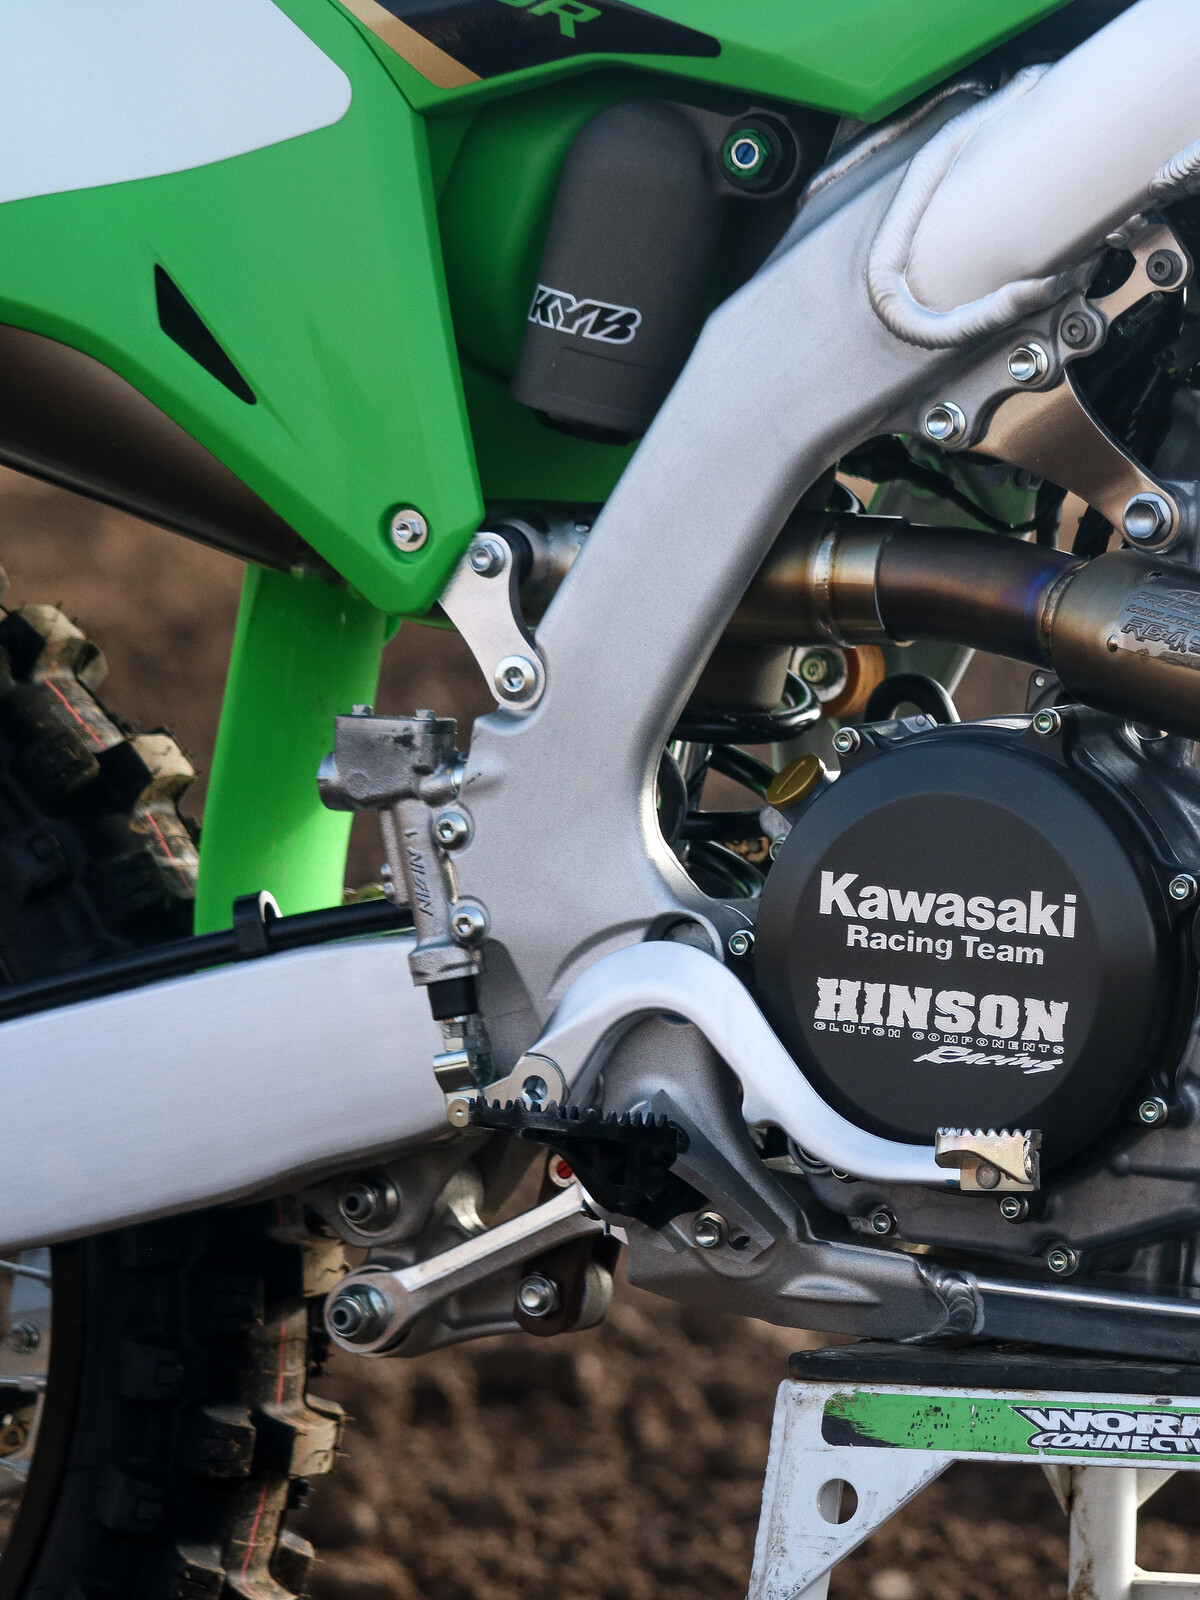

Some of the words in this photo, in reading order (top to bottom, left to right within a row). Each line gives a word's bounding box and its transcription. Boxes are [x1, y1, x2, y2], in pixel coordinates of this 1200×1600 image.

[497, 0, 602, 39] R
[528, 284, 642, 345] KYB
[819, 870, 1077, 938] Kawasaki
[847, 924, 953, 960] Racing
[960, 935, 1044, 965] Team
[814, 977, 1069, 1042] HINSON
[813, 1021, 901, 1038] CLUTCH
[912, 1031, 1065, 1054] COMPONENTS
[913, 1045, 1064, 1074] Racing
